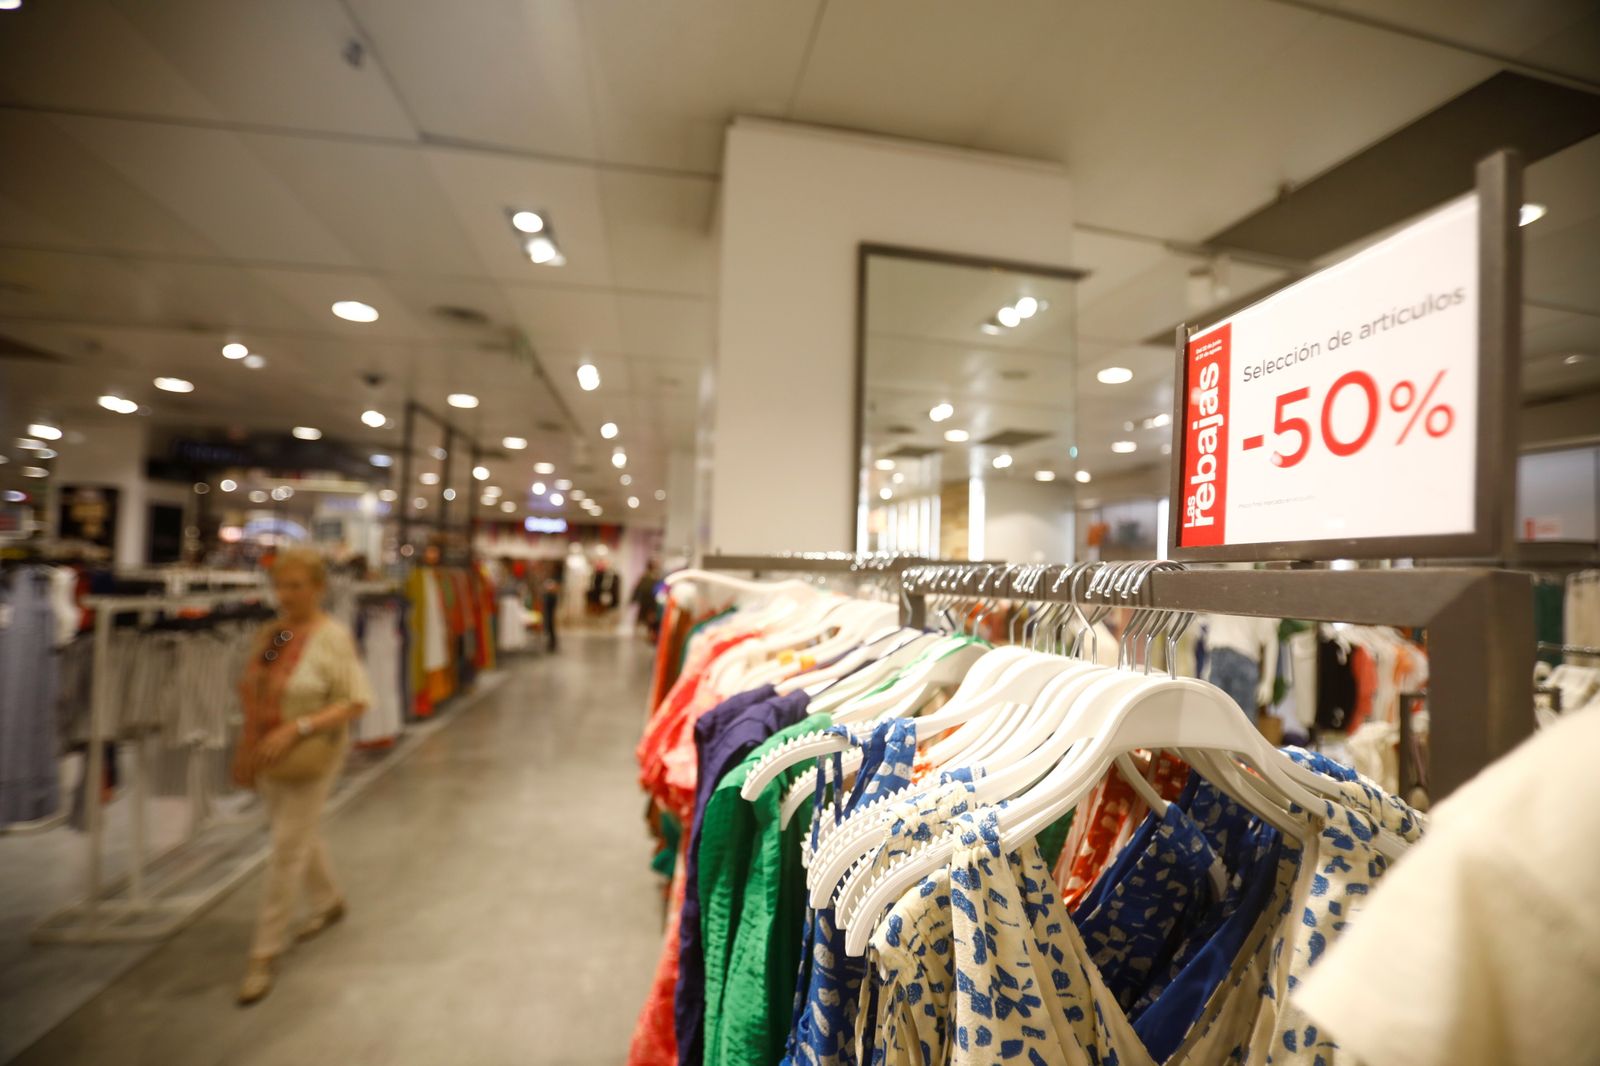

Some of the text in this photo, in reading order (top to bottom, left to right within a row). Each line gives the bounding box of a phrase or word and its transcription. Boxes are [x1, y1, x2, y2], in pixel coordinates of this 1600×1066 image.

[1242, 285, 1466, 383] Selección de artículos
[1191, 361, 1225, 527] rebajas
[1242, 370, 1456, 469] -50%
[1184, 495, 1196, 528] Las
